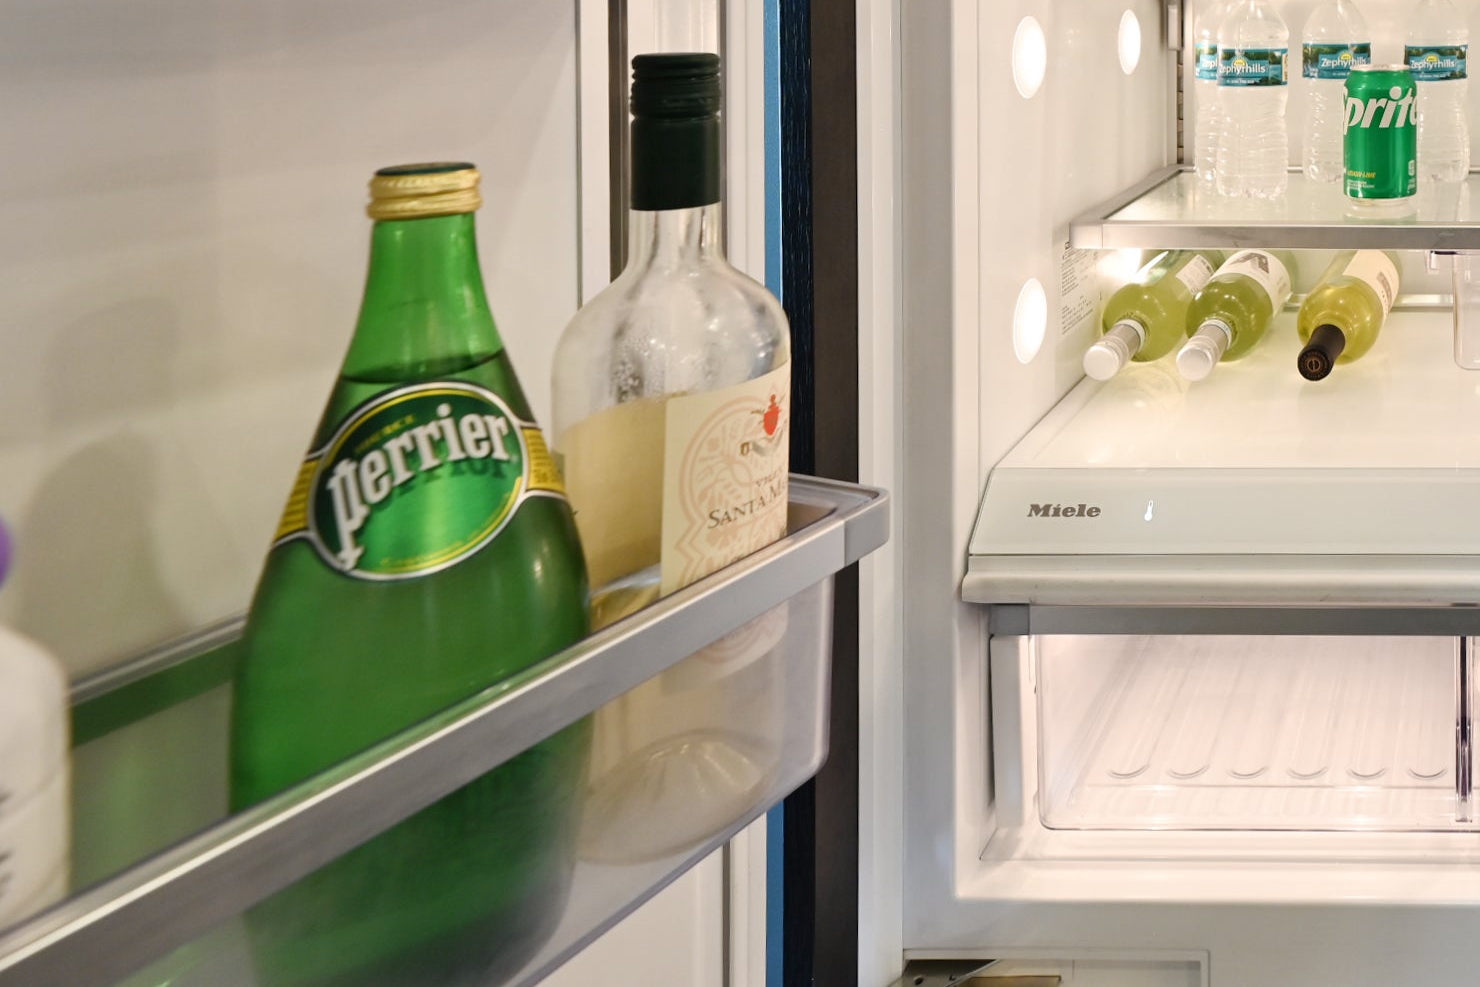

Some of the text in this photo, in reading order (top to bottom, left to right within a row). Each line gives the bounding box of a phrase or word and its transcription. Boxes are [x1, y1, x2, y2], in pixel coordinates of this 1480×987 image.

[326, 403, 510, 571] perrier
[708, 495, 765, 529] SANTA
[1027, 503, 1101, 517] Miele
